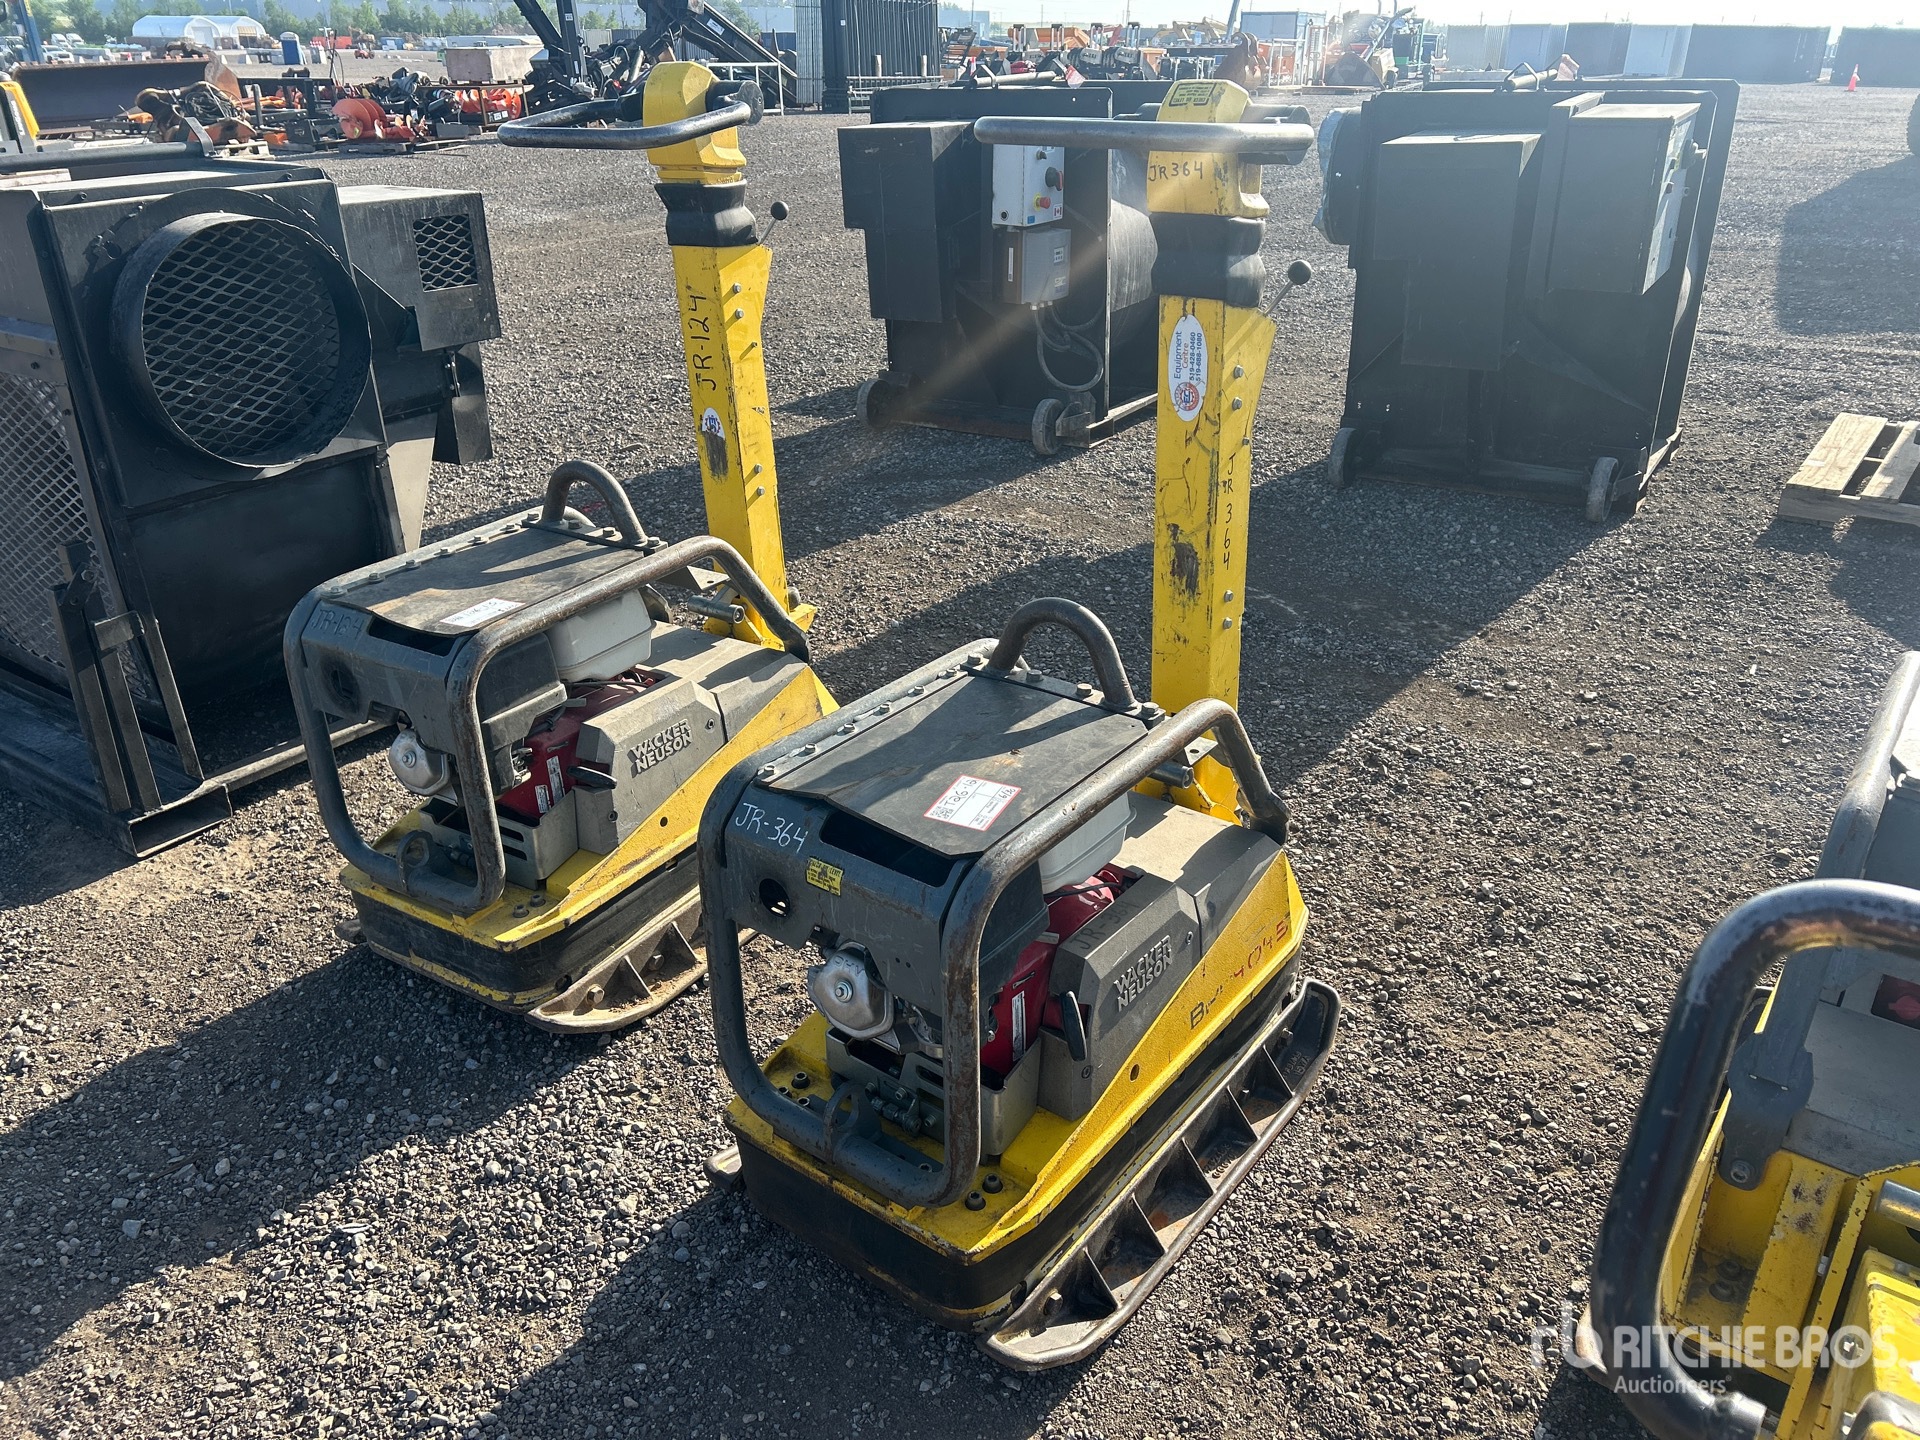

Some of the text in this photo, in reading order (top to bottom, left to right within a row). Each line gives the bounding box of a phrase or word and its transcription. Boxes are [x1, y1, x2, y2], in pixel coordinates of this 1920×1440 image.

[688, 294, 716, 391] JR-124
[1174, 331, 1182, 379] Equipment
[629, 718, 692, 760] WACKER
[633, 730, 694, 775] NEUSON
[735, 802, 809, 853] JR-364
[1112, 934, 1172, 994] WACKER
[1116, 950, 1174, 1012] NEUSON
